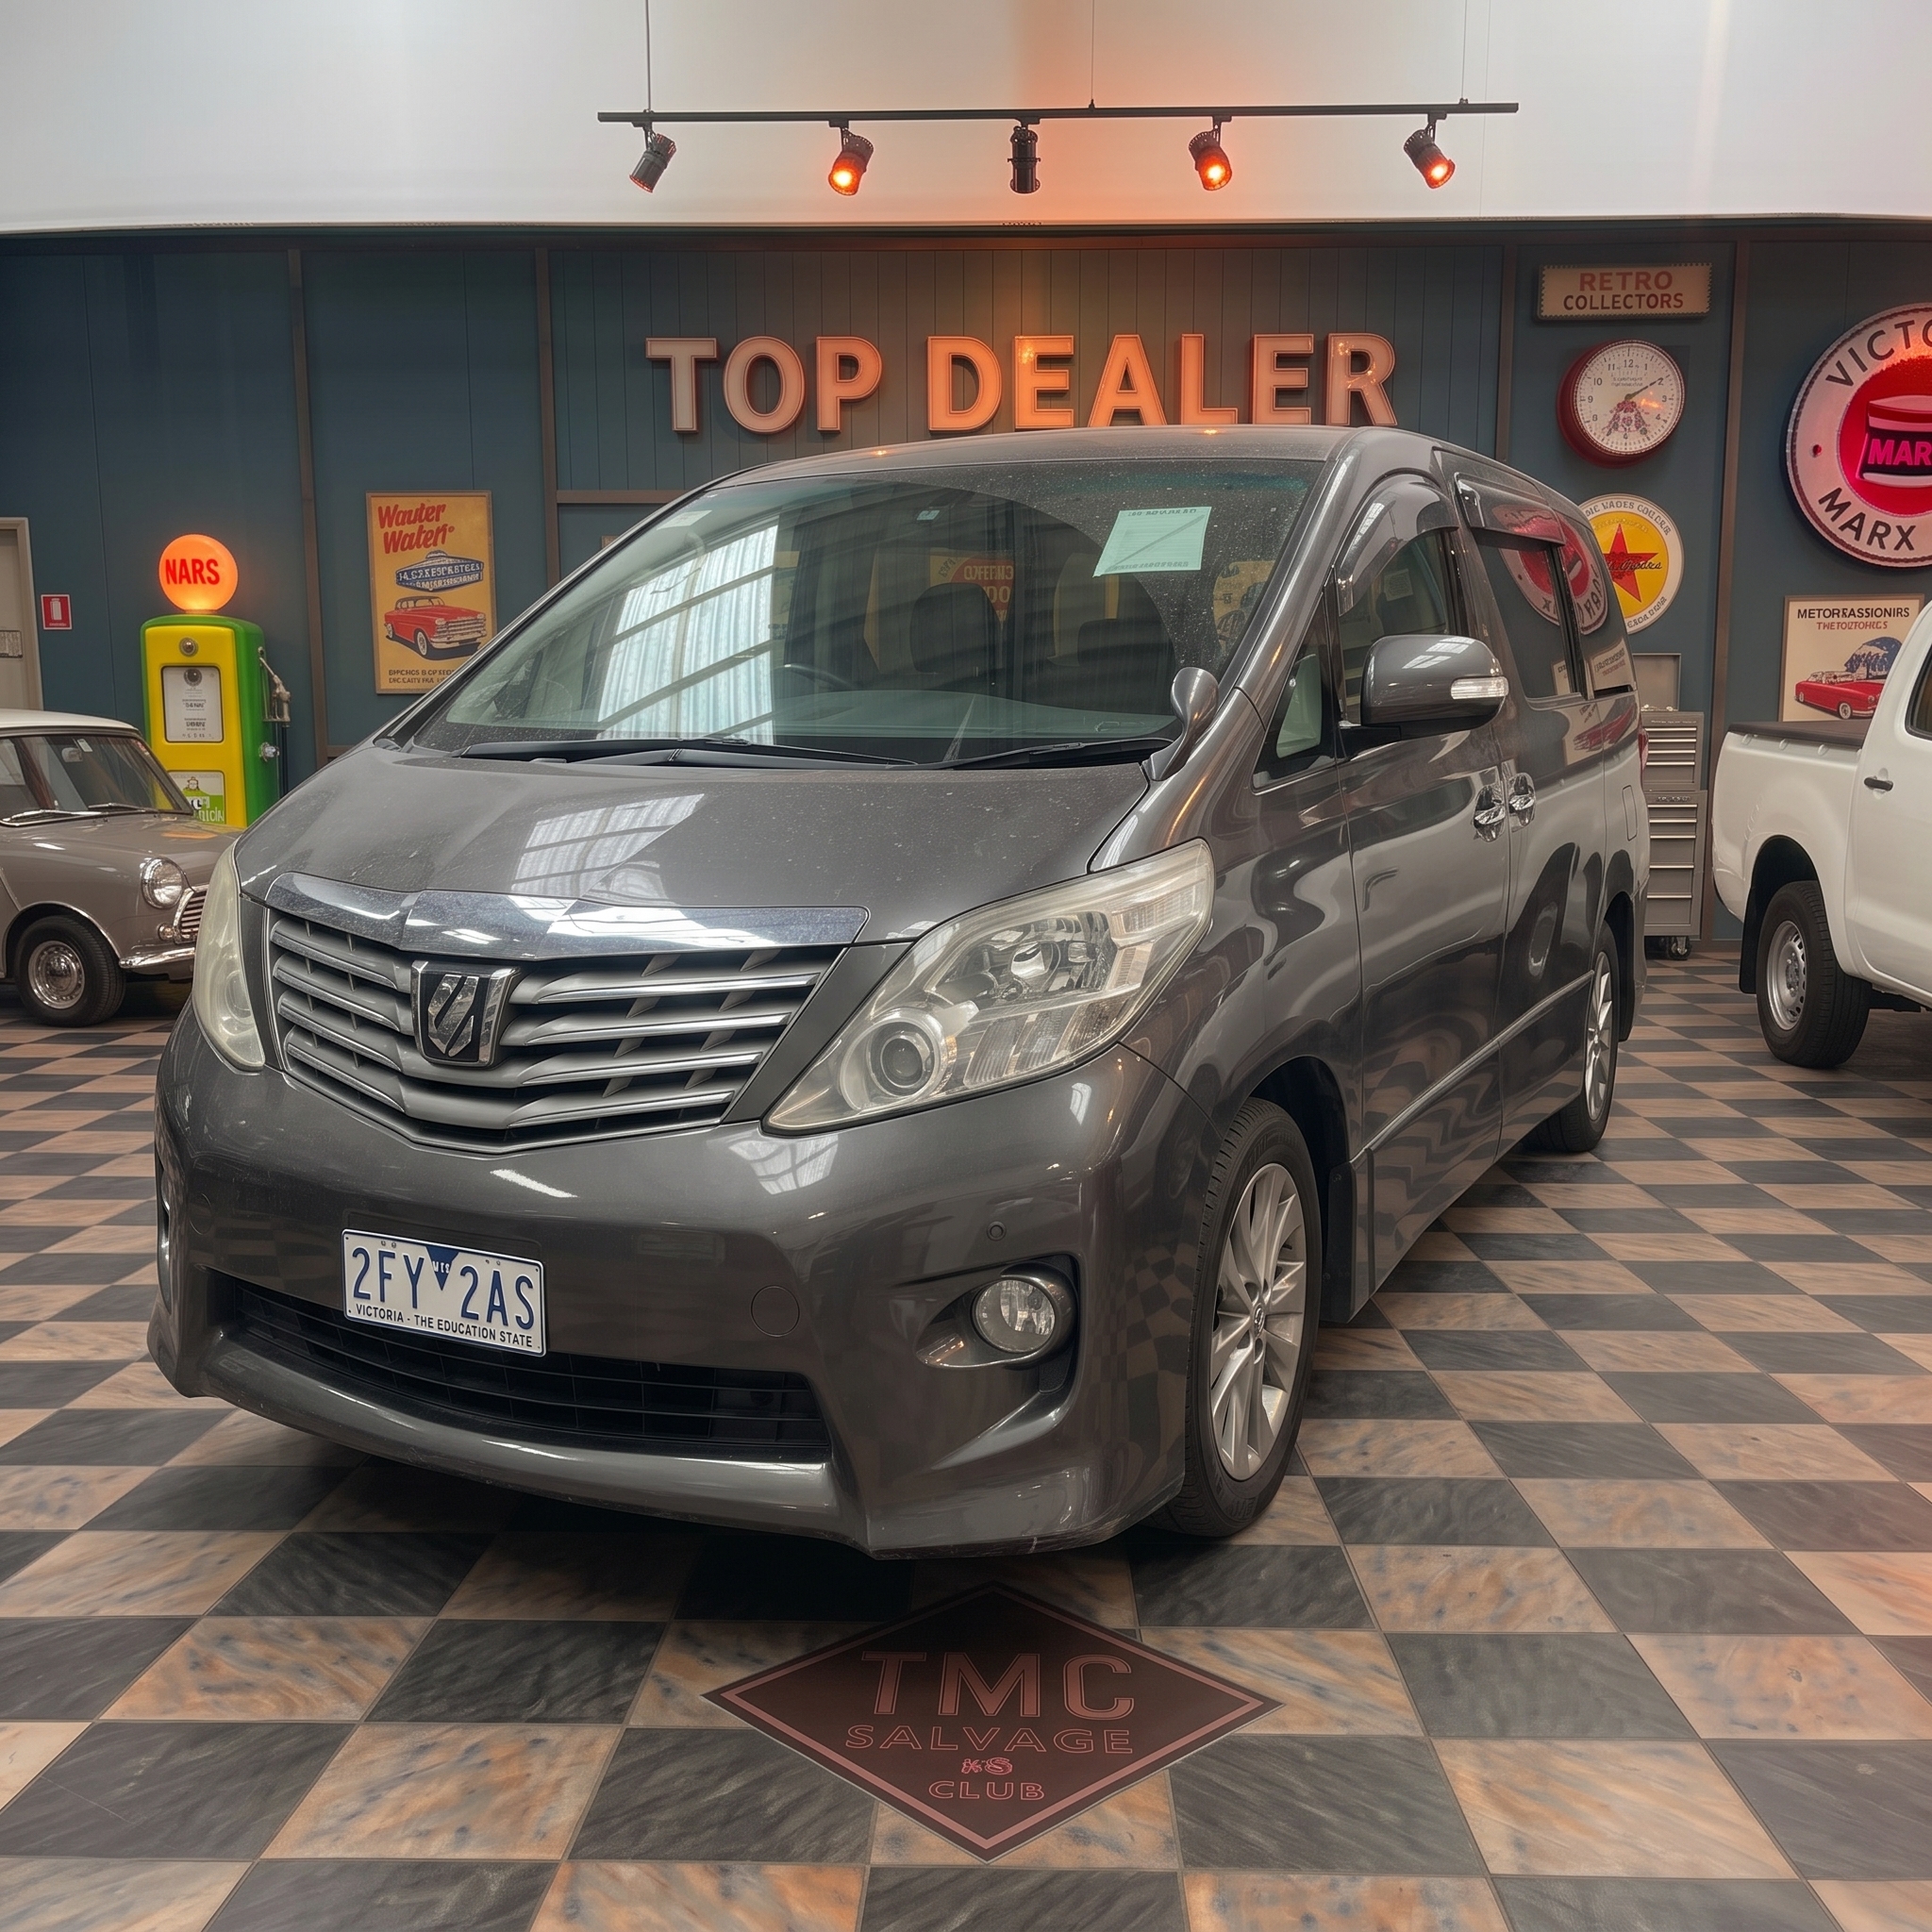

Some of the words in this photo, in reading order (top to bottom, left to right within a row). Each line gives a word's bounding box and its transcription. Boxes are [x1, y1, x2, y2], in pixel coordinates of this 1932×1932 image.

[1579, 271, 1674, 291] RETRO
[1563, 292, 1684, 310] COLLECTORS
[1624, 359, 1634, 368] 12
[645, 335, 883, 433] TOP
[926, 332, 1399, 433] DEALER
[1593, 377, 1603, 386] 10
[1588, 395, 1593, 404] 9
[1818, 487, 1916, 552] MARX
[165, 558, 220, 585] NARS
[352, 1246, 425, 1309] 2FY
[459, 1265, 534, 1330] 2AS
[356, 1304, 404, 1323] VICTORIA
[414, 1315, 434, 1329] THE
[437, 1319, 496, 1341] EDUCATION
[499, 1331, 532, 1347] STATE
[861, 1651, 1135, 1721] TMC
[845, 1724, 1133, 1754] SALVAGE
[929, 1780, 1044, 1800] CLUB
